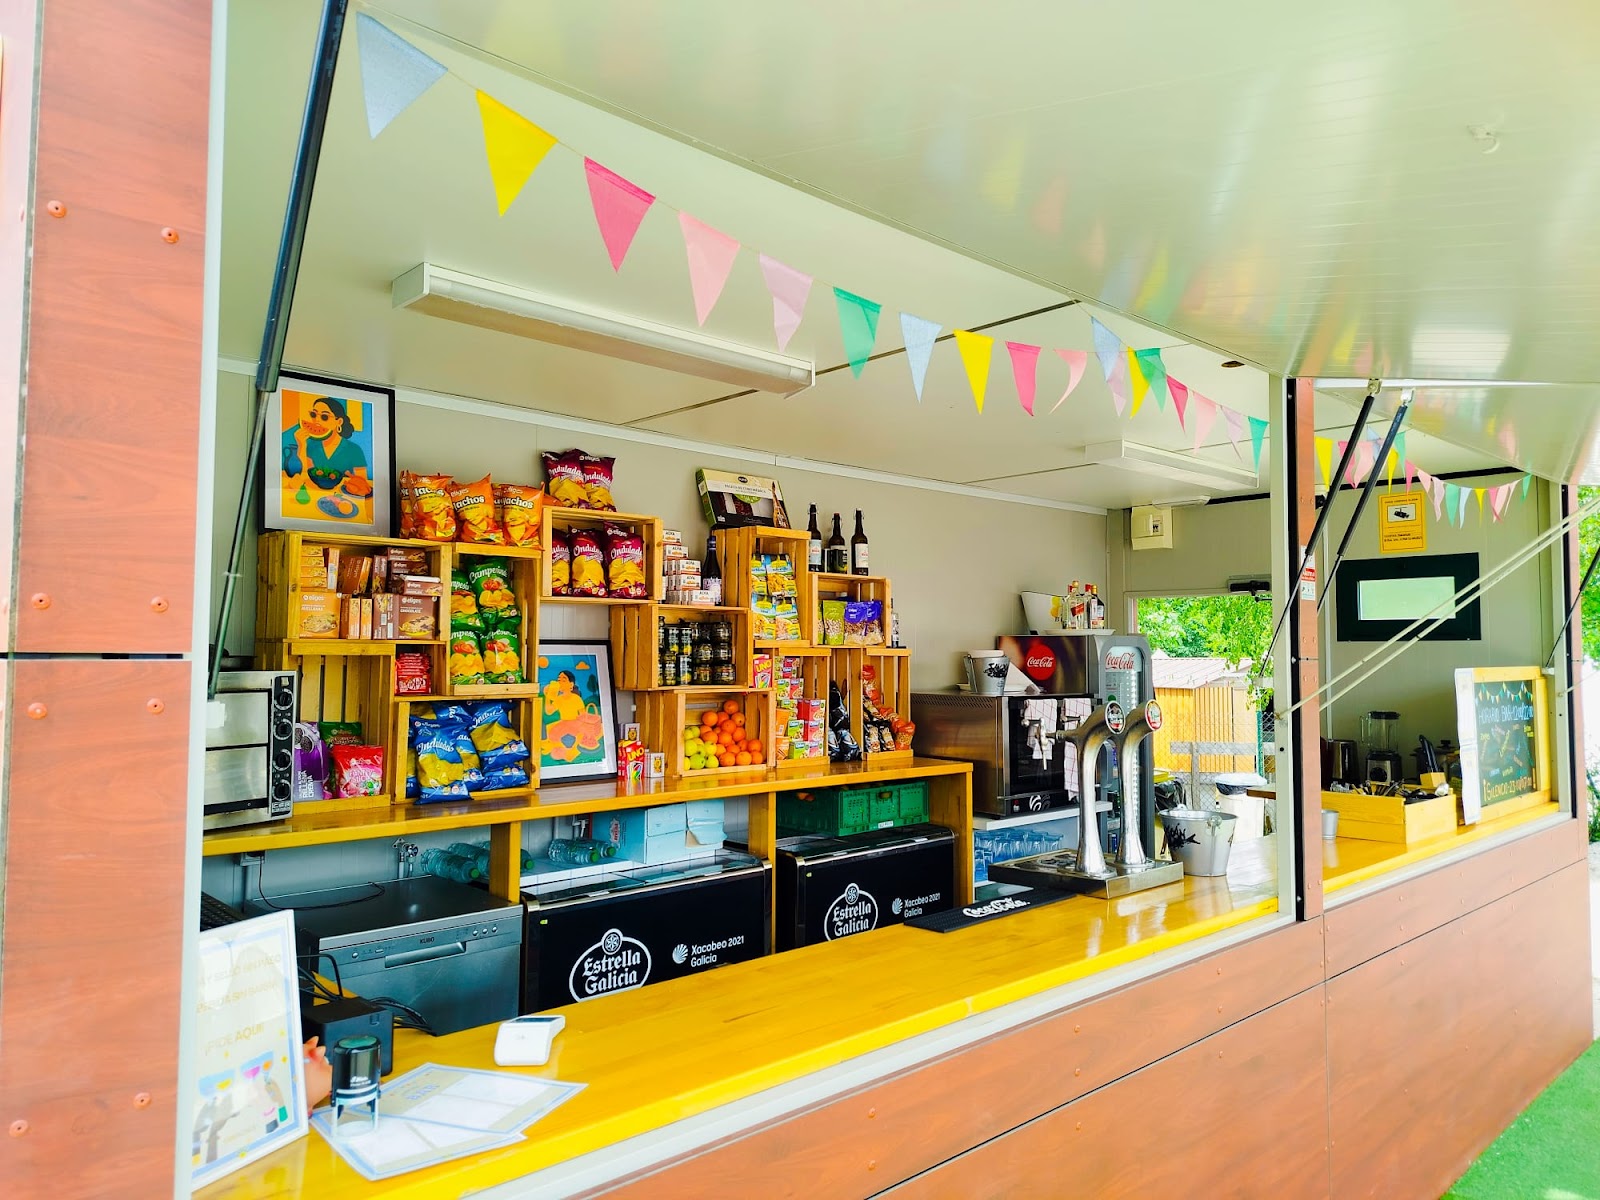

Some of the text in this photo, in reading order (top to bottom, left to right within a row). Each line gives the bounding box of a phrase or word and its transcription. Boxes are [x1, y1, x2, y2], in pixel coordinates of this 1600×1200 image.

[755, 660, 772, 673] UNO
[627, 747, 645, 762] UNO
[904, 892, 941, 908] Xacobeo 2021
[832, 901, 872, 922] Estrella
[904, 907, 923, 918] Galicia
[834, 916, 869, 937] Galicia
[690, 934, 745, 957] Xacobeo 2021
[583, 949, 641, 977] Estrella
[690, 953, 718, 968] Galicia
[585, 968, 638, 995] Galicia
